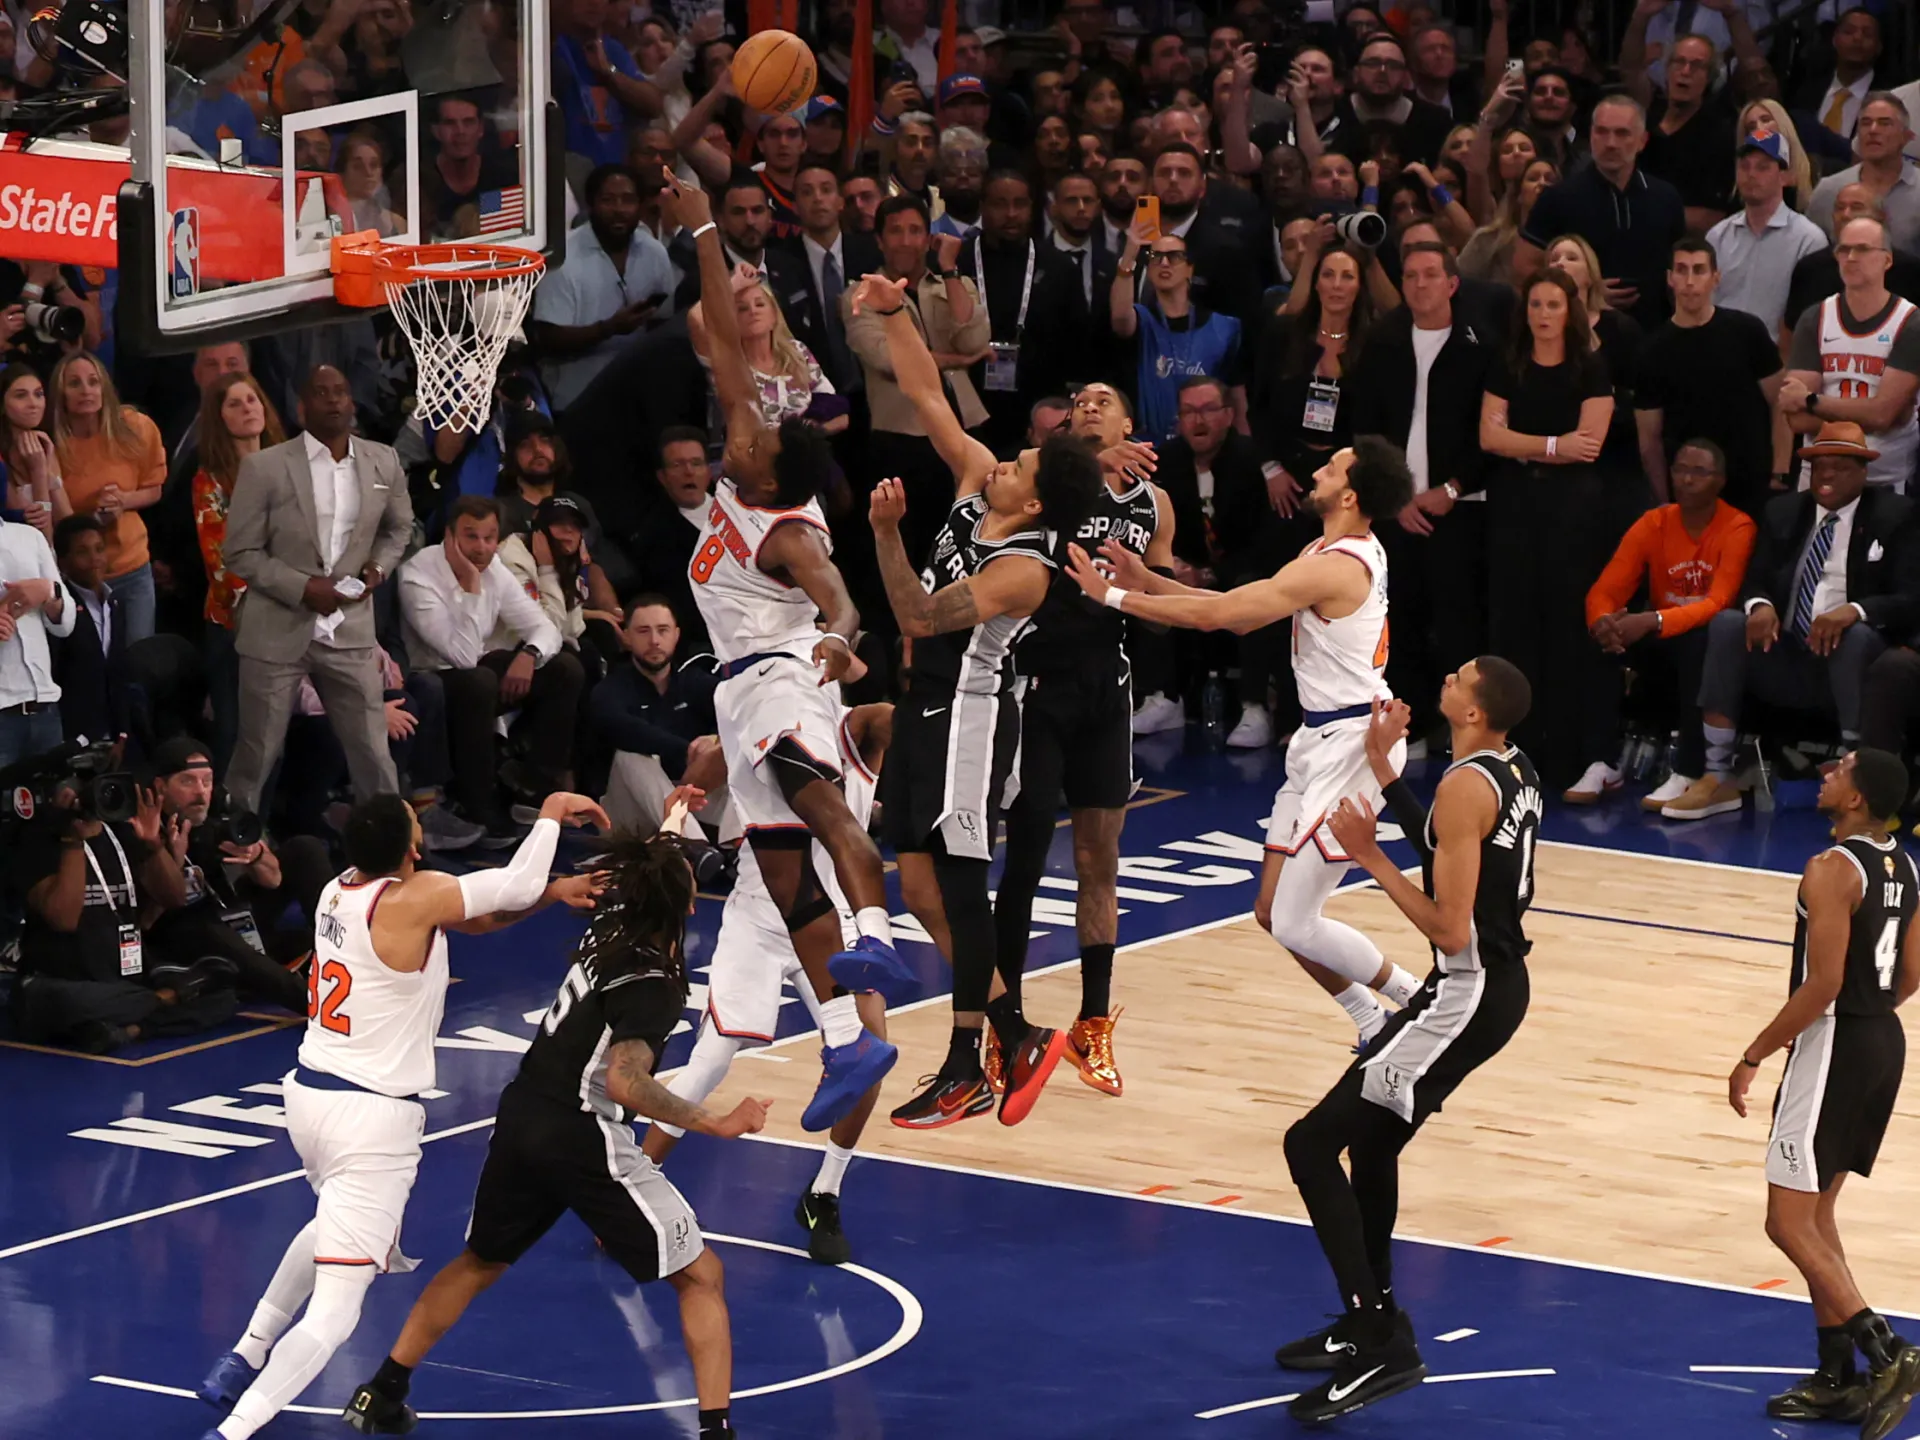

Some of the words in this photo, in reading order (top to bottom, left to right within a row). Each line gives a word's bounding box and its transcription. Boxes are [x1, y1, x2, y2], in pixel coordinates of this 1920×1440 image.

[690, 533, 726, 586] 8
[1076, 516, 1152, 555] SPURS
[1517, 825, 1534, 900] 1
[1883, 881, 1905, 909] FOX
[1874, 916, 1902, 990] 4
[544, 961, 592, 1037] 5
